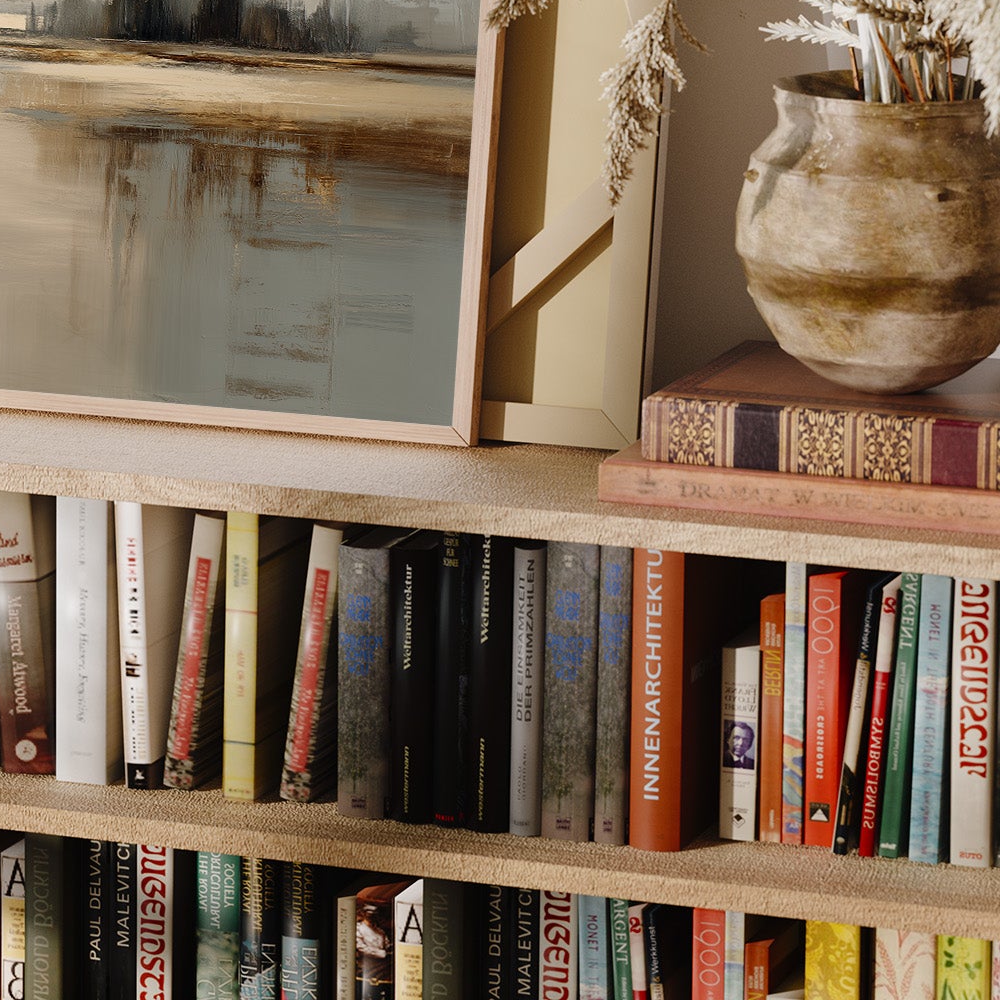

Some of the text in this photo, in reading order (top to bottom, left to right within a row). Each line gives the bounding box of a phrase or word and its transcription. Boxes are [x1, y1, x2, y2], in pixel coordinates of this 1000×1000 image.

[6, 595, 32, 714] Margaret Atwood
[403, 564, 413, 671] Weltarchitektur
[516, 575, 525, 722] DIE EINSAMKEIT
[524, 559, 535, 722] DER PRIMZAHLEN
[478, 738, 486, 821] westermann
[89, 918, 102, 962] PAUL
[584, 915, 598, 952] MONET
[648, 926, 660, 976] Werkkunst
[695, 921, 721, 987] 1900
